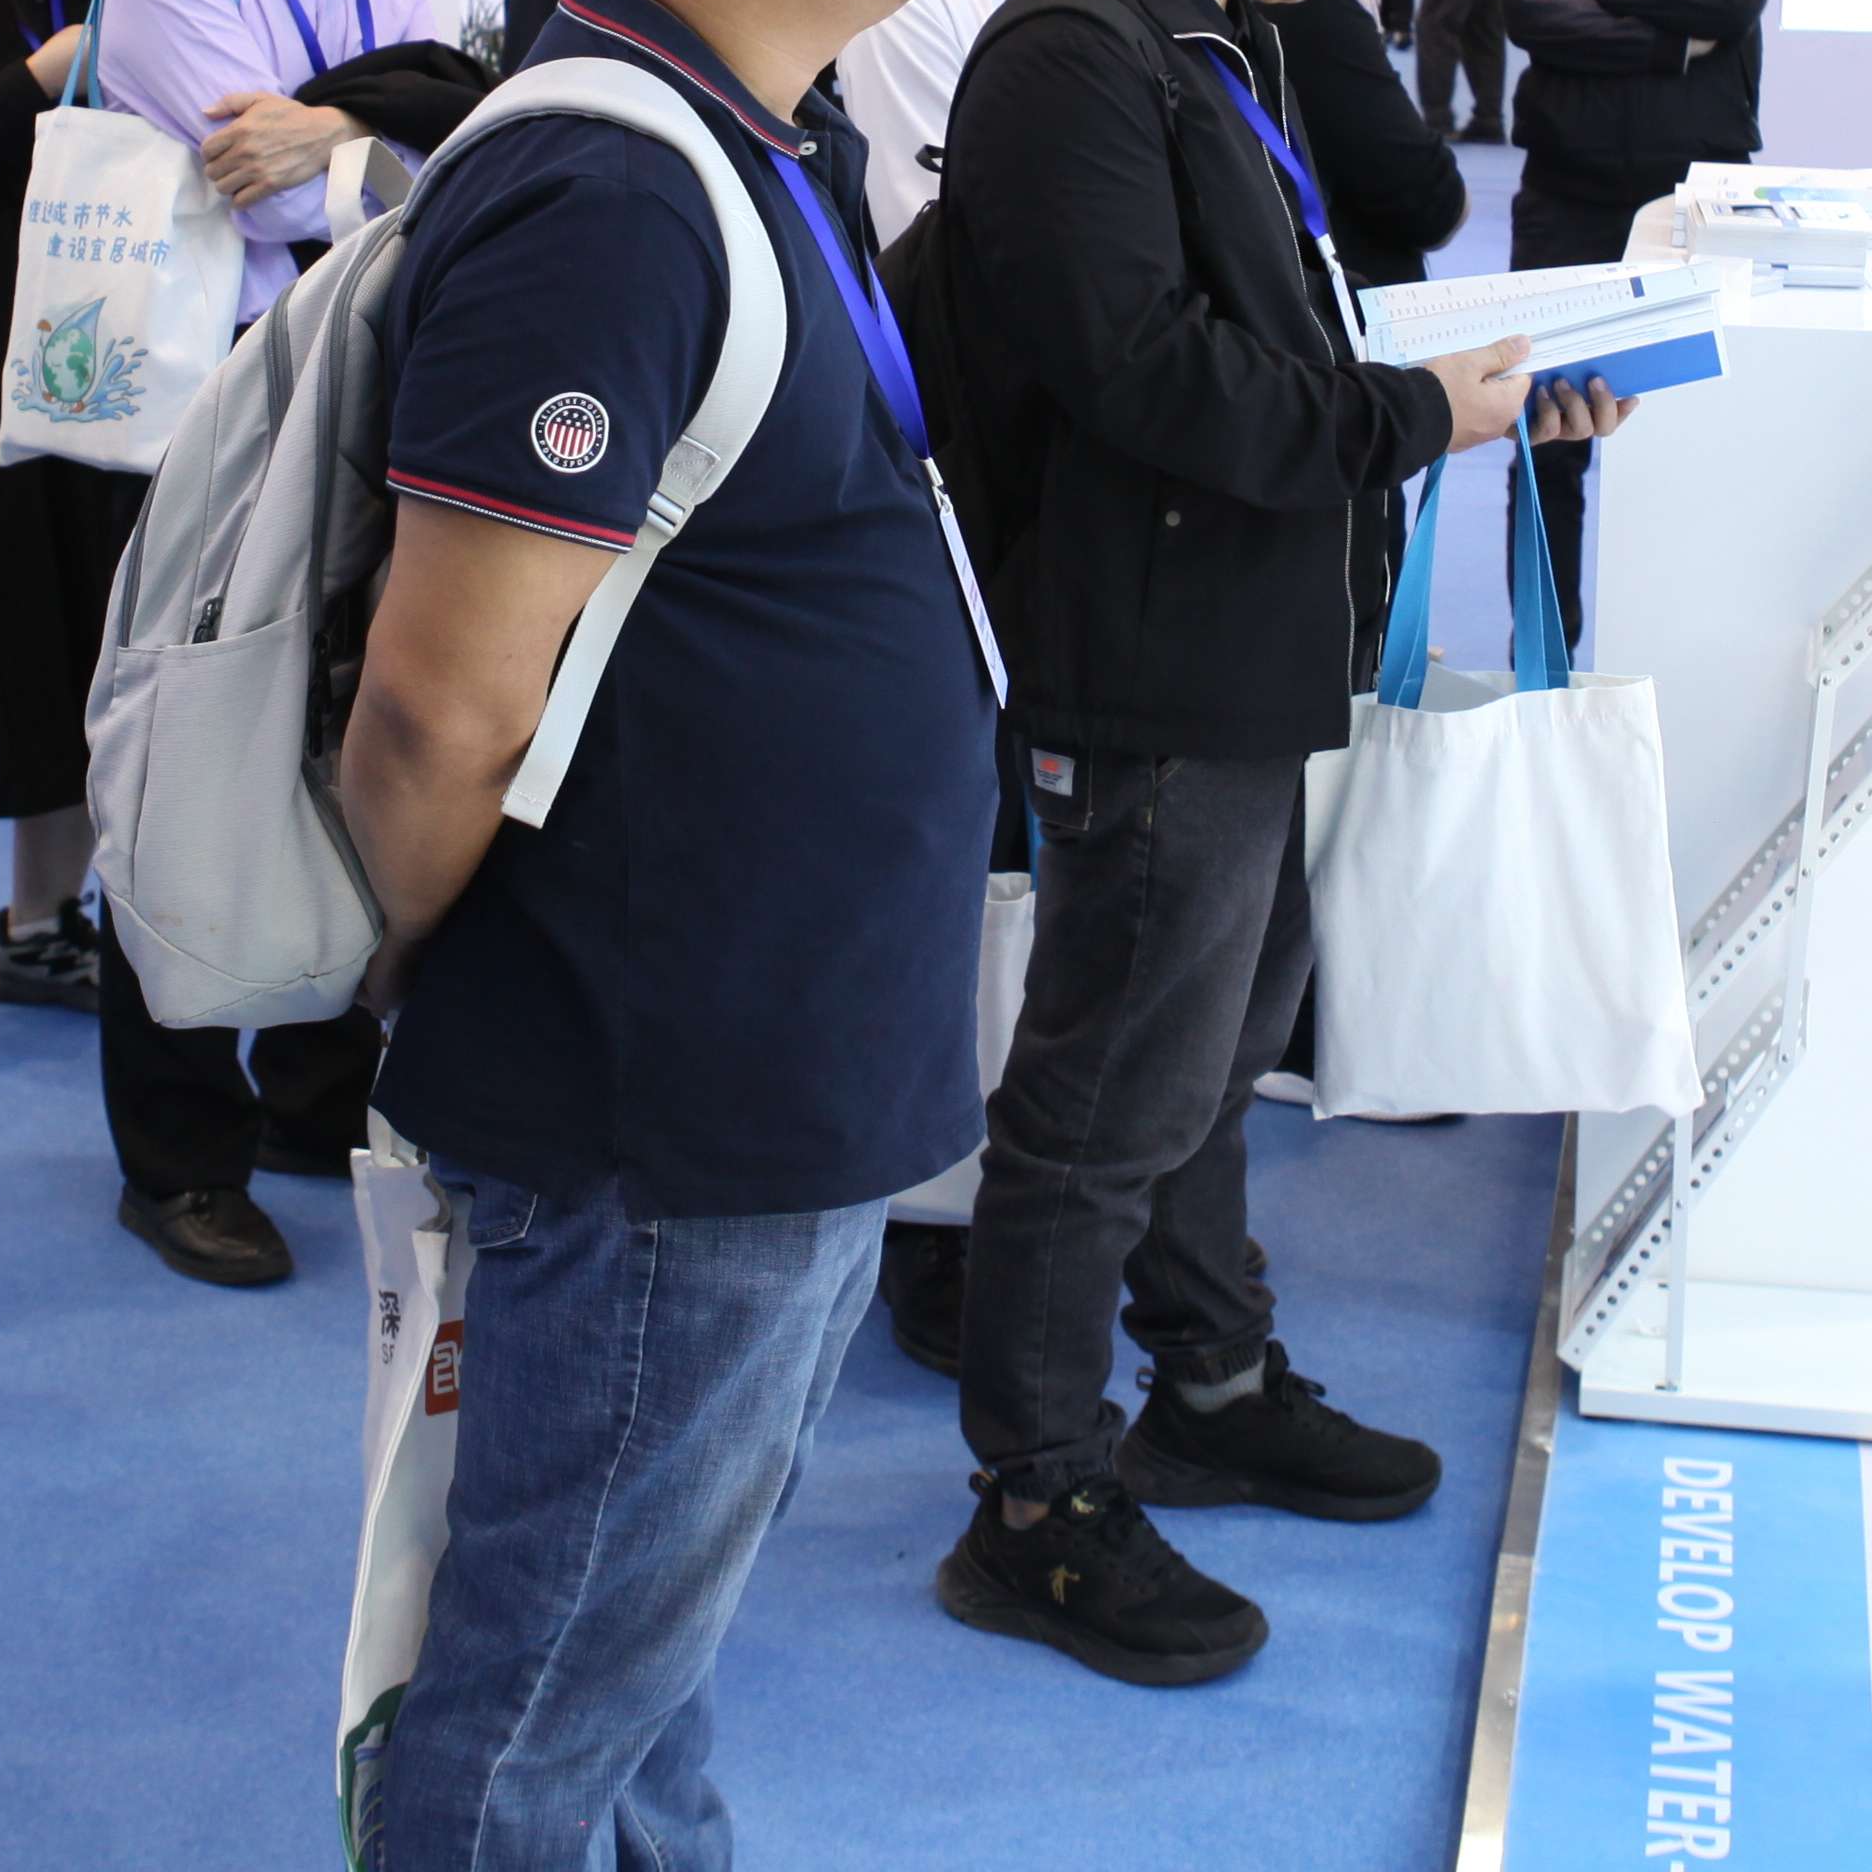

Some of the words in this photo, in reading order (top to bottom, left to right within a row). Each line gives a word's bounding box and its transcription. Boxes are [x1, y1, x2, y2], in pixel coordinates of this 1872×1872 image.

[47, 231, 171, 267] 建设宜居城市
[563, 450, 595, 467] SPORT
[1657, 1456, 1734, 1653] DEVELOP
